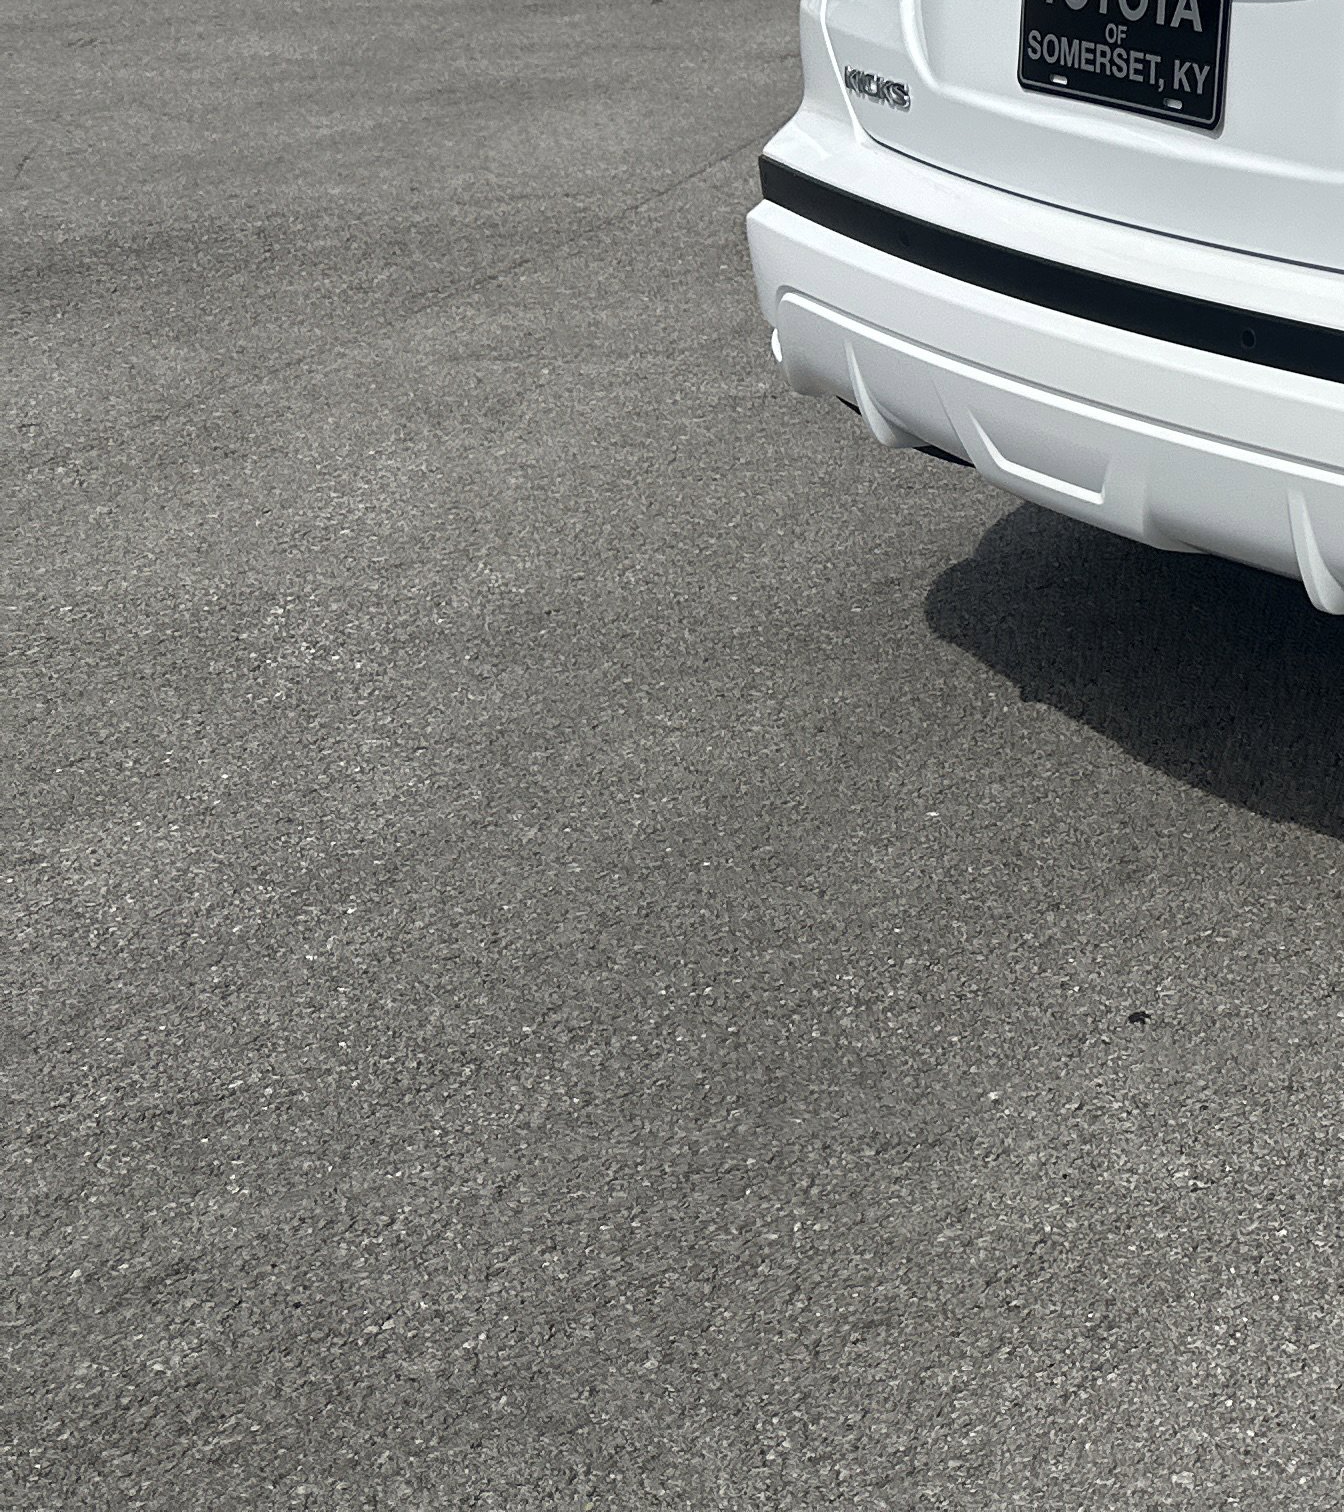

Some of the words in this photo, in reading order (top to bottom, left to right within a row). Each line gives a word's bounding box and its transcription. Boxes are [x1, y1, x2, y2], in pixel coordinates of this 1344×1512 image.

[1105, 23, 1128, 45] OF
[1027, 29, 1165, 92] SOMERSET,
[1172, 59, 1211, 95] KY
